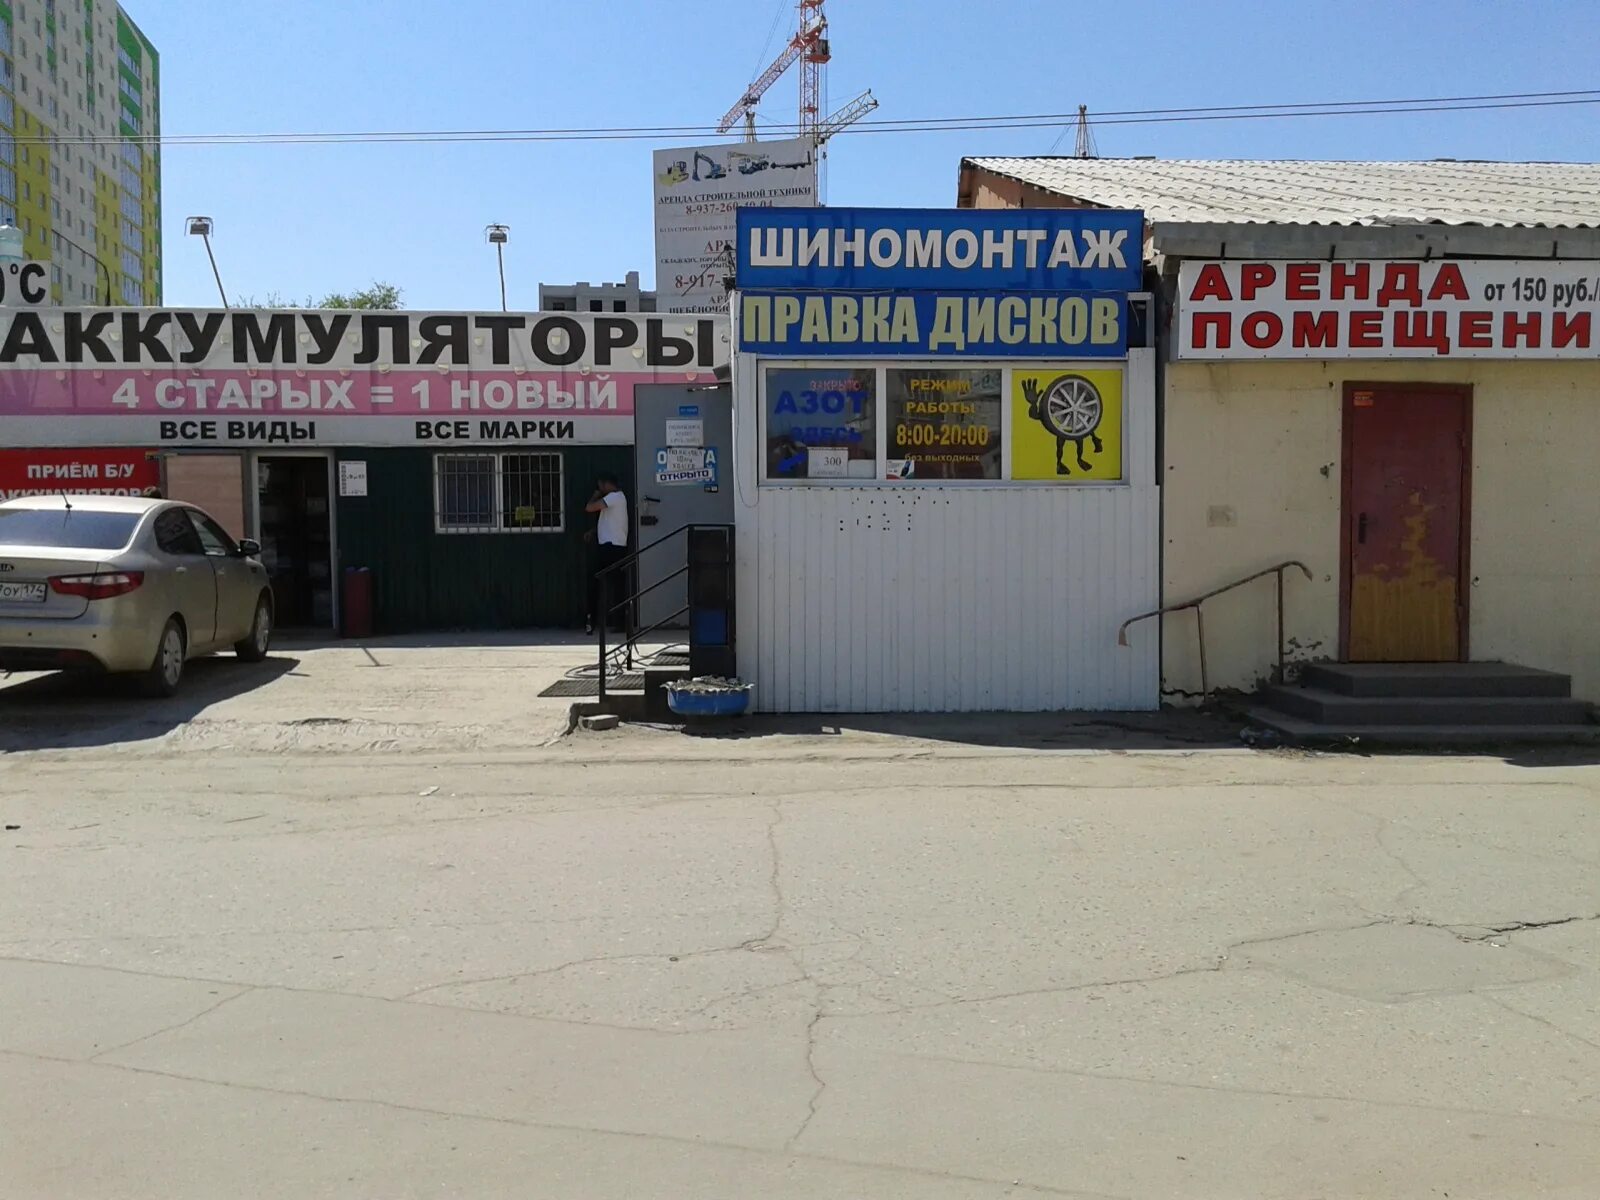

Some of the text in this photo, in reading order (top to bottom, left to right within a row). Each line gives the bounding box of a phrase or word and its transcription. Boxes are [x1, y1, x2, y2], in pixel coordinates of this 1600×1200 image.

[769, 187, 811, 197] ТЕХНИКИ
[750, 227, 1129, 269] ШИНОМОНТАЖ
[1189, 263, 1470, 307] АРЕНДА
[1484, 284, 1505, 301] от
[1512, 277, 1547, 301] 150
[743, 296, 1120, 351] ПРАВКА ДИСКОВ
[0, 312, 714, 367] АККУМУЛЯТОРЫ
[112, 379, 139, 408] 4
[154, 378, 356, 409] СТАРЫХ
[411, 380, 430, 408] 1
[451, 374, 617, 409] НОВЫЙ
[910, 379, 970, 392] РЕЖИМ
[774, 390, 869, 414] АЗОТ
[906, 401, 975, 414] РАБОТЫ
[160, 421, 316, 443] ВСЕ ВИДЫ
[415, 421, 575, 439] ВСЕ МАРКИ
[896, 423, 989, 446] 8:00-20:00
[824, 456, 842, 466] 300
[925, 454, 980, 463] выходных
[27, 463, 135, 479] ПРИЁМ Б/У
[660, 469, 709, 480] ОТКРЫТО
